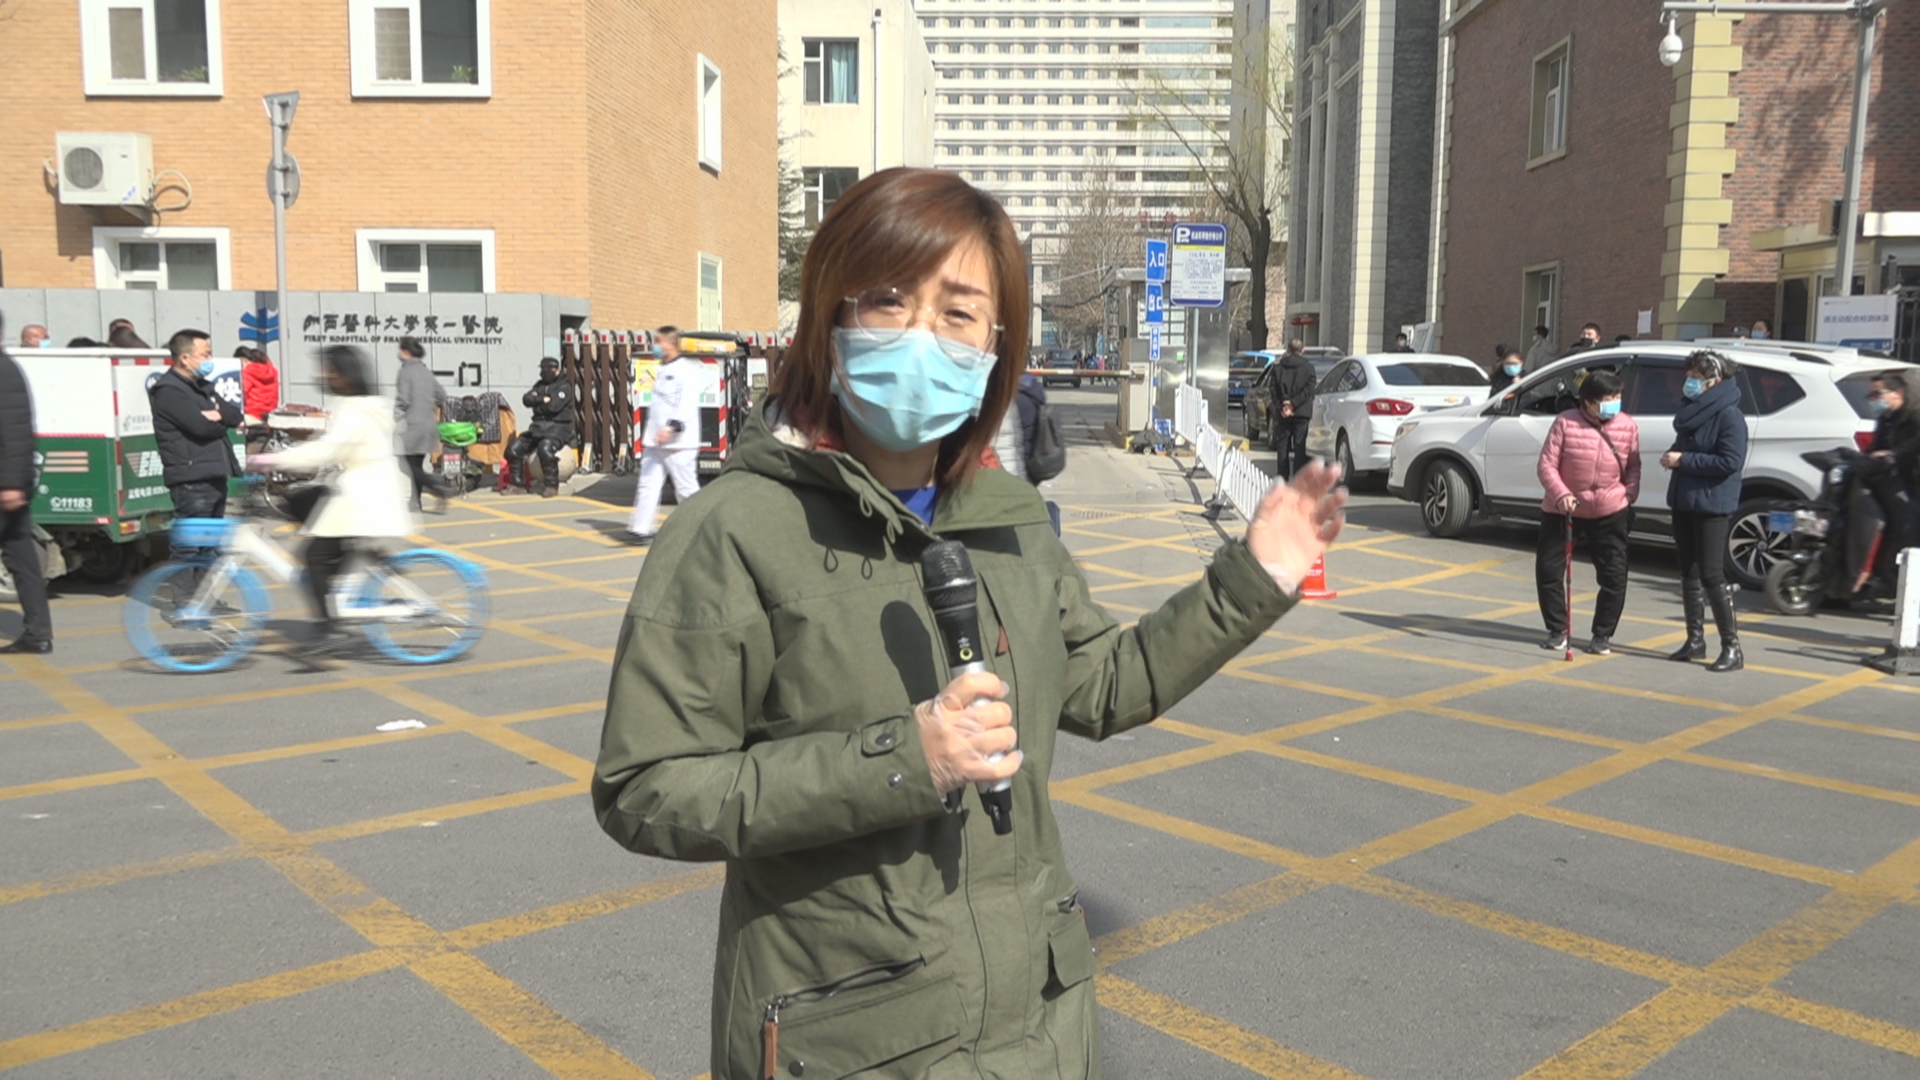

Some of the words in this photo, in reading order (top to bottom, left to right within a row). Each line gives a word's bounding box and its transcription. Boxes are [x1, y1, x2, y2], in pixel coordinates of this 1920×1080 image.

[1149, 251, 1164, 267] 入口
[1148, 294, 1162, 311] 出口
[304, 335, 327, 343] FIRST
[329, 335, 369, 343] HOSPITAL
[417, 336, 451, 344] MEDICAL
[454, 336, 503, 345] UNIVERSITY
[214, 376, 242, 402] 快
[138, 451, 164, 478] EM
[61, 497, 93, 509] 11183
